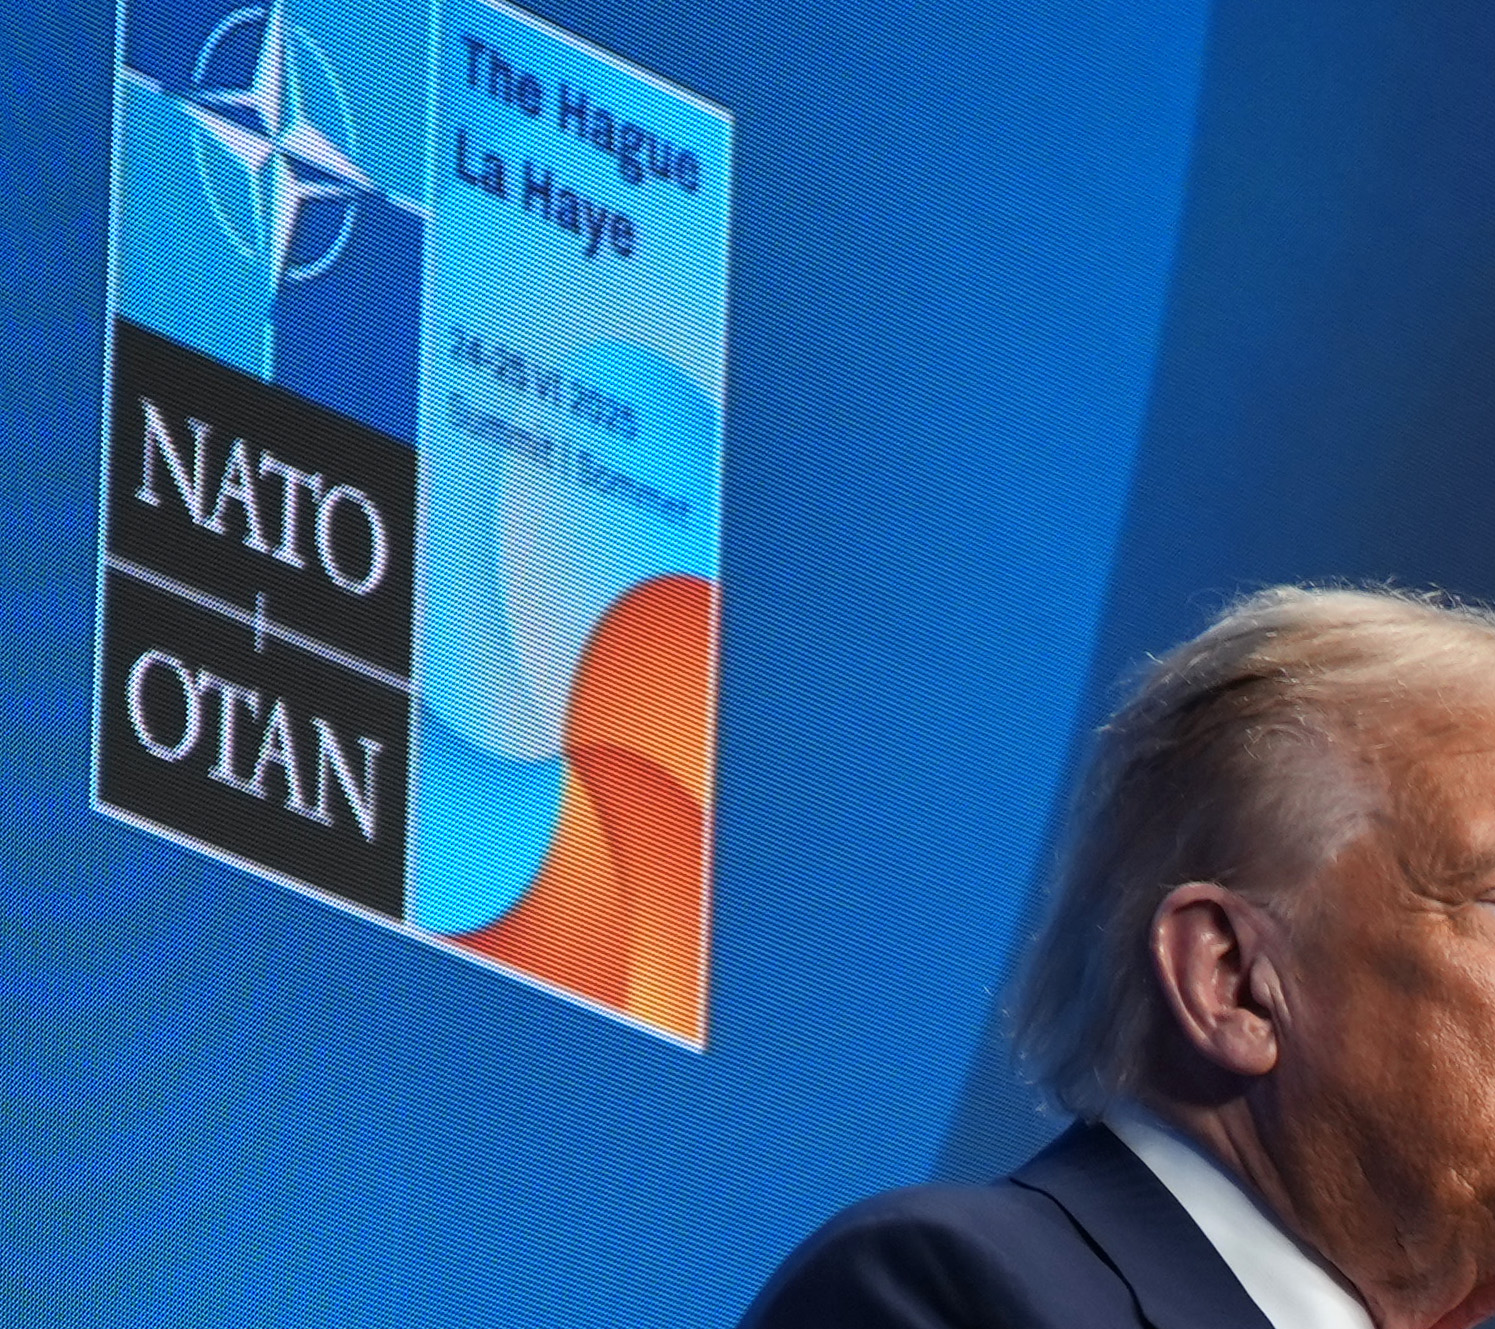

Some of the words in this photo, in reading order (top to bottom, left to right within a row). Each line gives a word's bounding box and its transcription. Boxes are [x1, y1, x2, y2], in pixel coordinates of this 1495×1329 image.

[456, 128, 506, 200] La
[523, 158, 635, 259] Haye
[461, 33, 544, 117] The
[557, 82, 701, 195] Hague
[569, 380, 639, 442] 2025
[135, 395, 389, 597] NATO
[124, 648, 384, 843] OTAN
